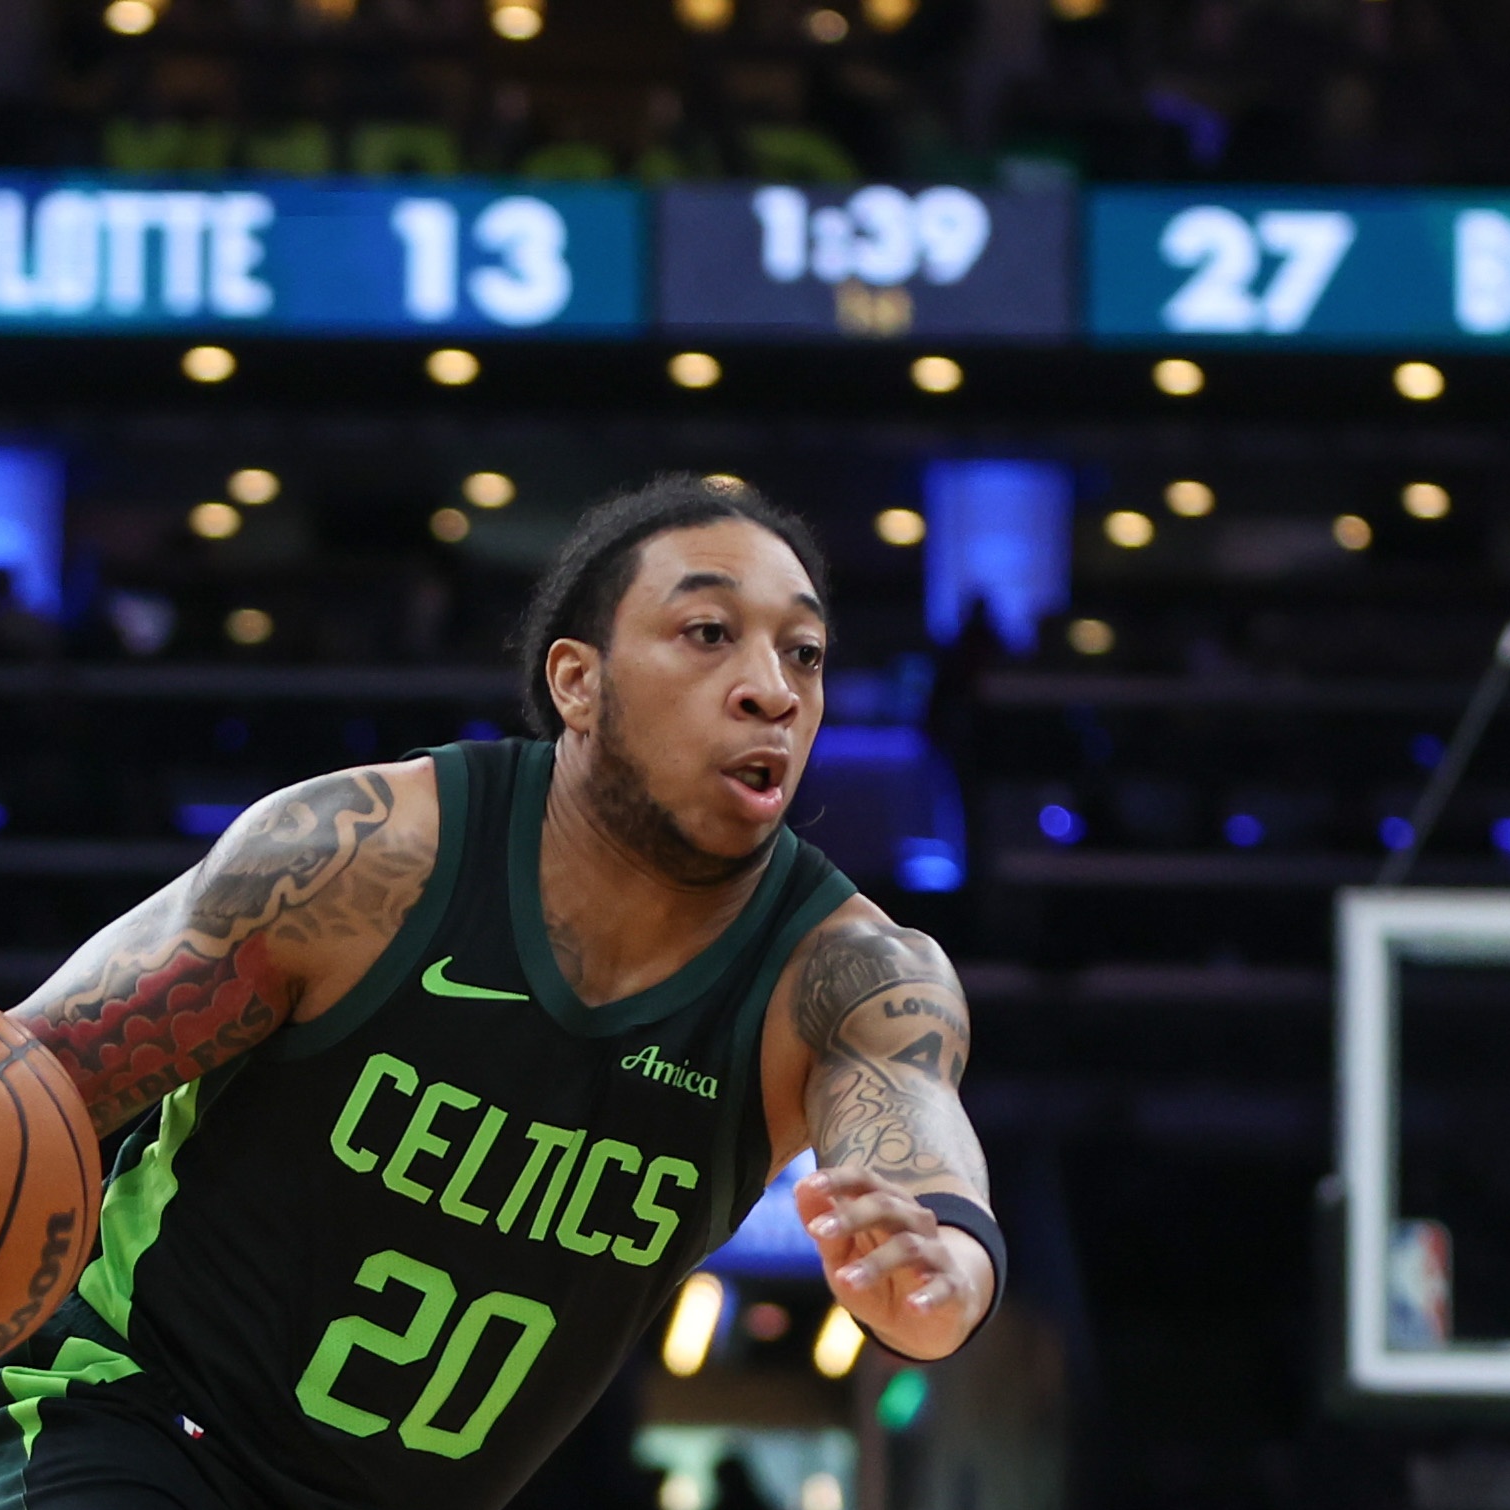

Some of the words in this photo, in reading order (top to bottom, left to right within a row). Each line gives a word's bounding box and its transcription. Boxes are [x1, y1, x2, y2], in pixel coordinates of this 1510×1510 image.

[391, 195, 573, 327] 13
[753, 185, 991, 286] 1:39
[1160, 205, 1355, 333] 27
[621, 1045, 718, 1099] Amica
[330, 1052, 699, 1266] CELTICS
[295, 1249, 557, 1459] 20
